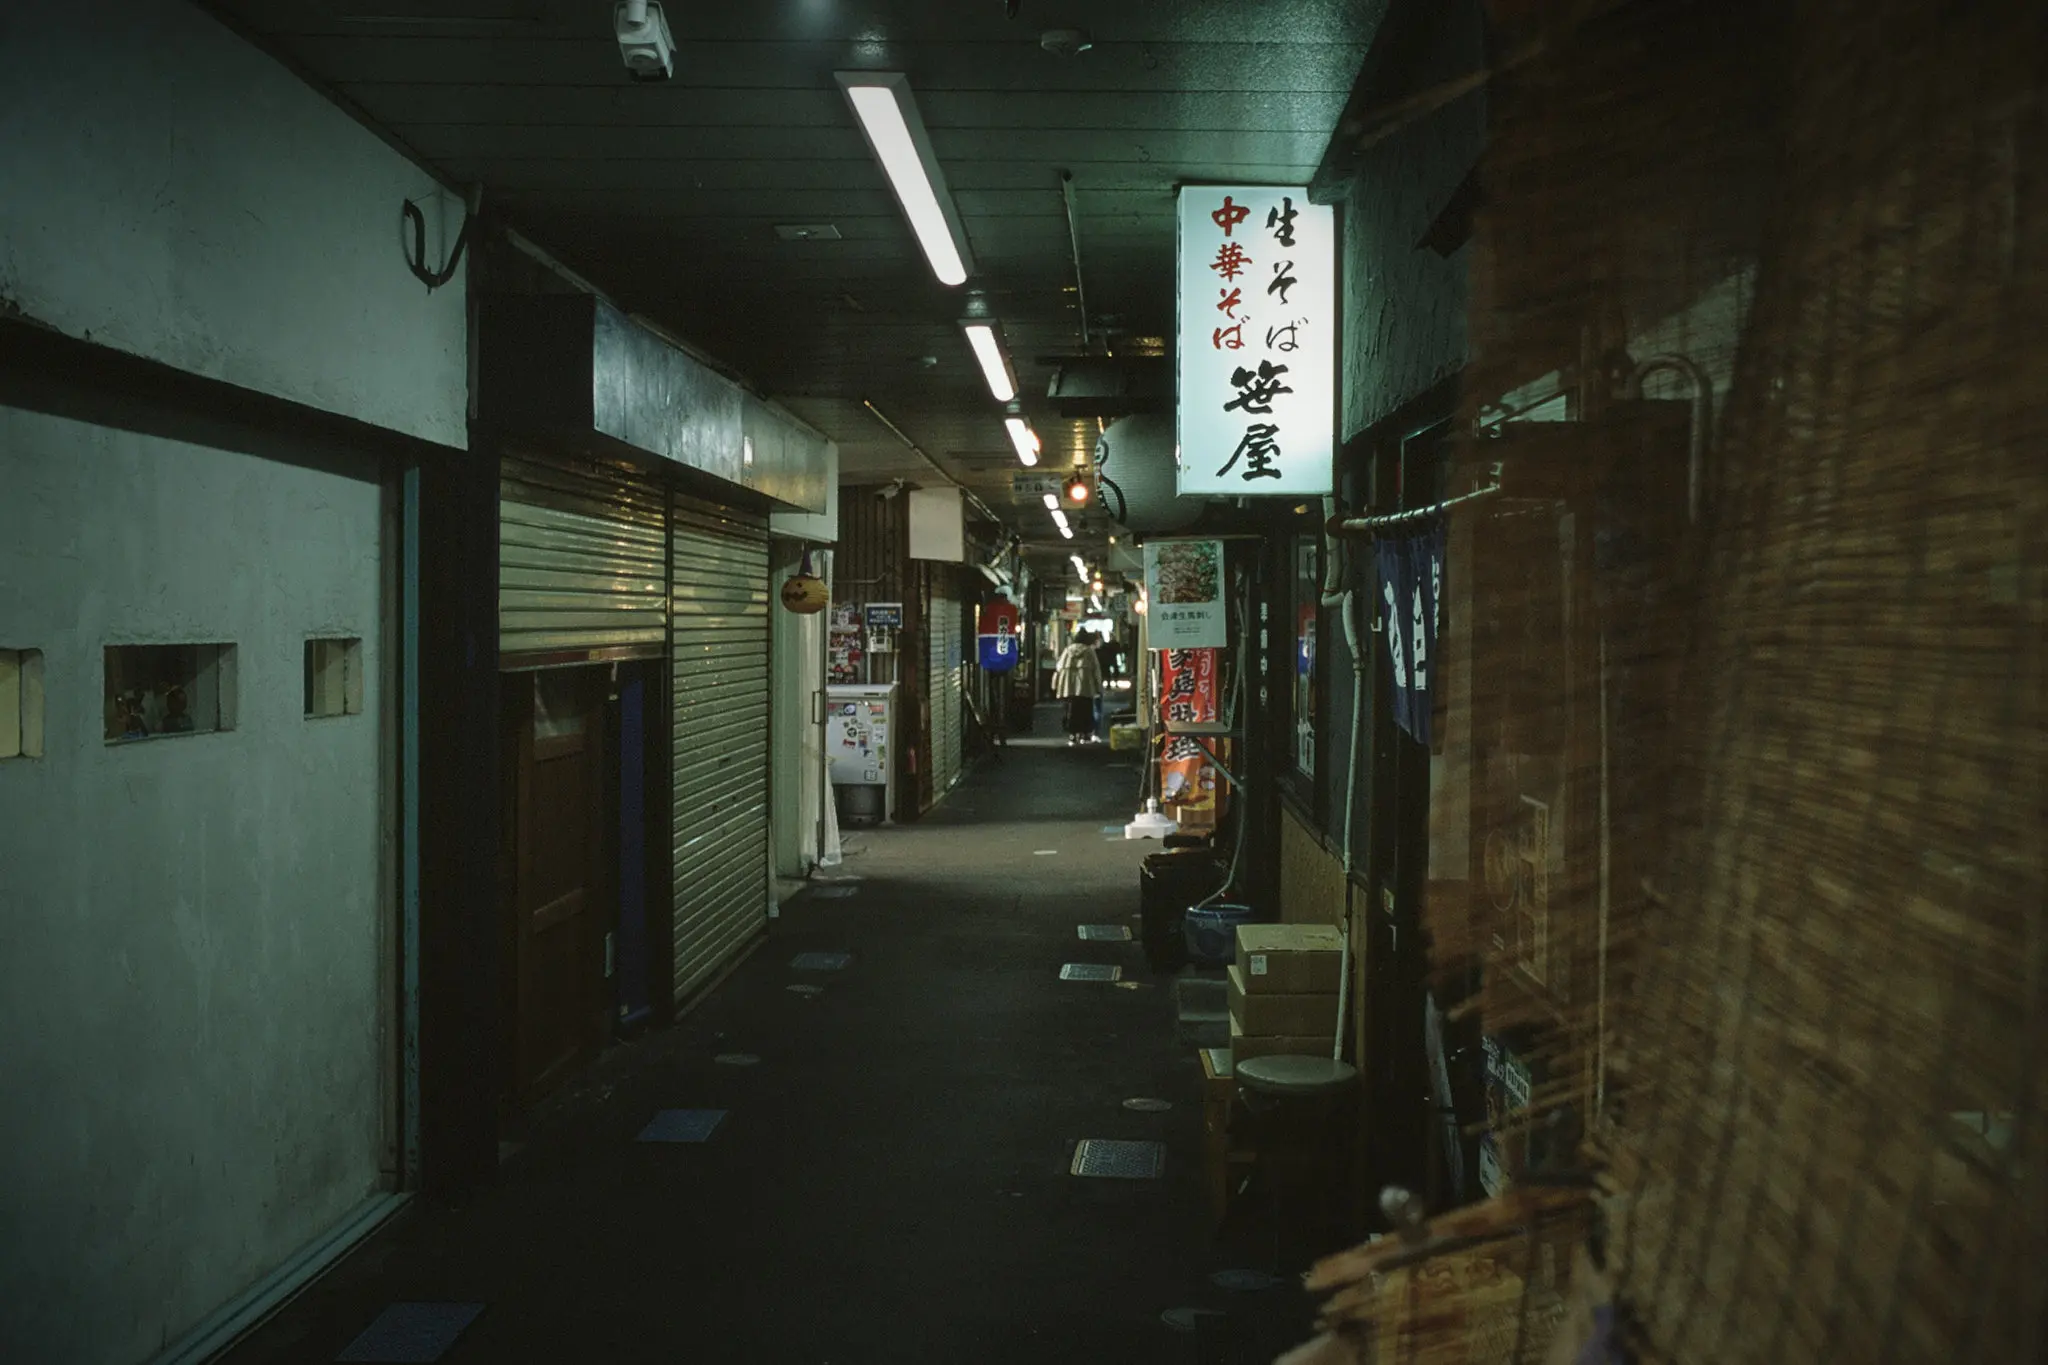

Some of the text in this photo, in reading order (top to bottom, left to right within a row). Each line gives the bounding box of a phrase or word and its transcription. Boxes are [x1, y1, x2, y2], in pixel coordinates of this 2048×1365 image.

[1209, 195, 1253, 349] 中華そば
[1265, 196, 1308, 352] 生そば
[1215, 359, 1294, 481] 笹屋
[1161, 611, 1212, 621] 会津生馬刺し
